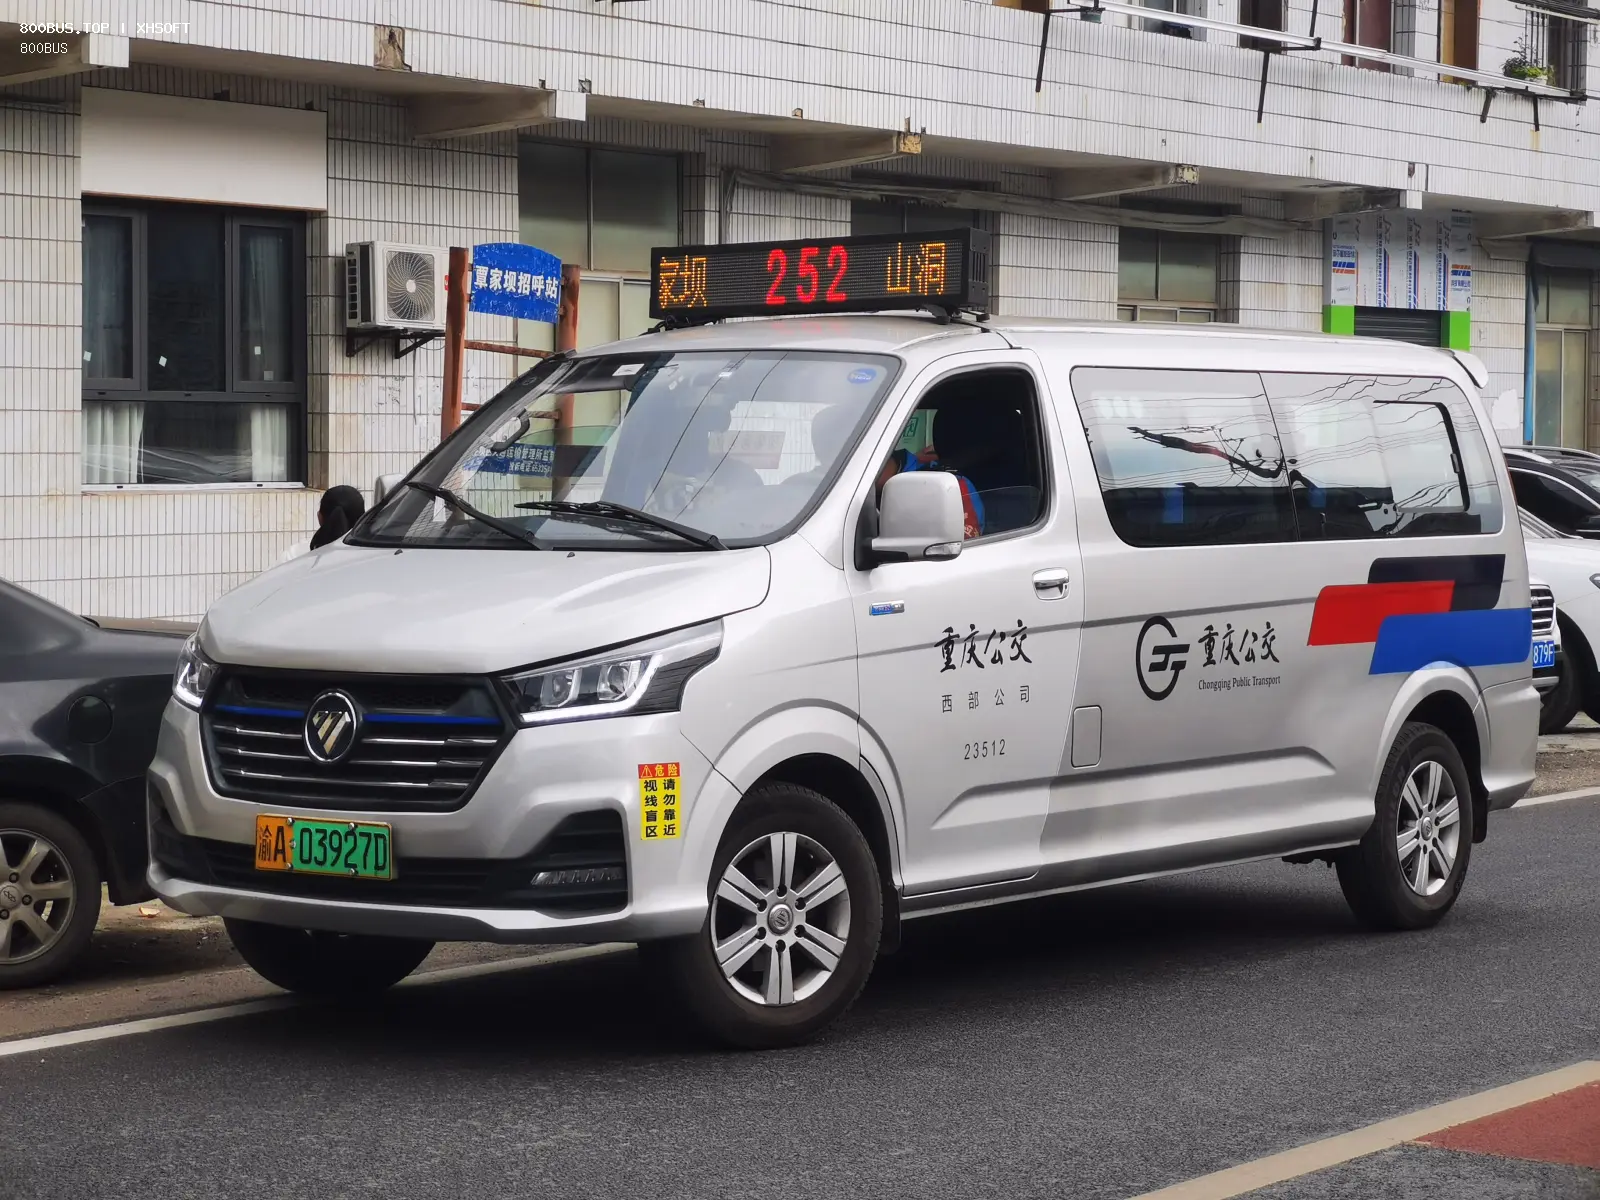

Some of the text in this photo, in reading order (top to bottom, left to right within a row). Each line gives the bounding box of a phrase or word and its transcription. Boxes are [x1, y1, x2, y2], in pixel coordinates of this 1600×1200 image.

[765, 245, 848, 305] 252
[886, 242, 946, 296] 山洞
[934, 618, 1033, 673] 重庆公交
[1197, 621, 1280, 668] 重庆公交
[1198, 675, 1281, 691] Chongqing Public Transport
[655, 763, 678, 777] 危险
[963, 738, 1006, 760] 23512
[643, 779, 658, 838] 视线盲区
[662, 778, 676, 836] 请勿靠近
